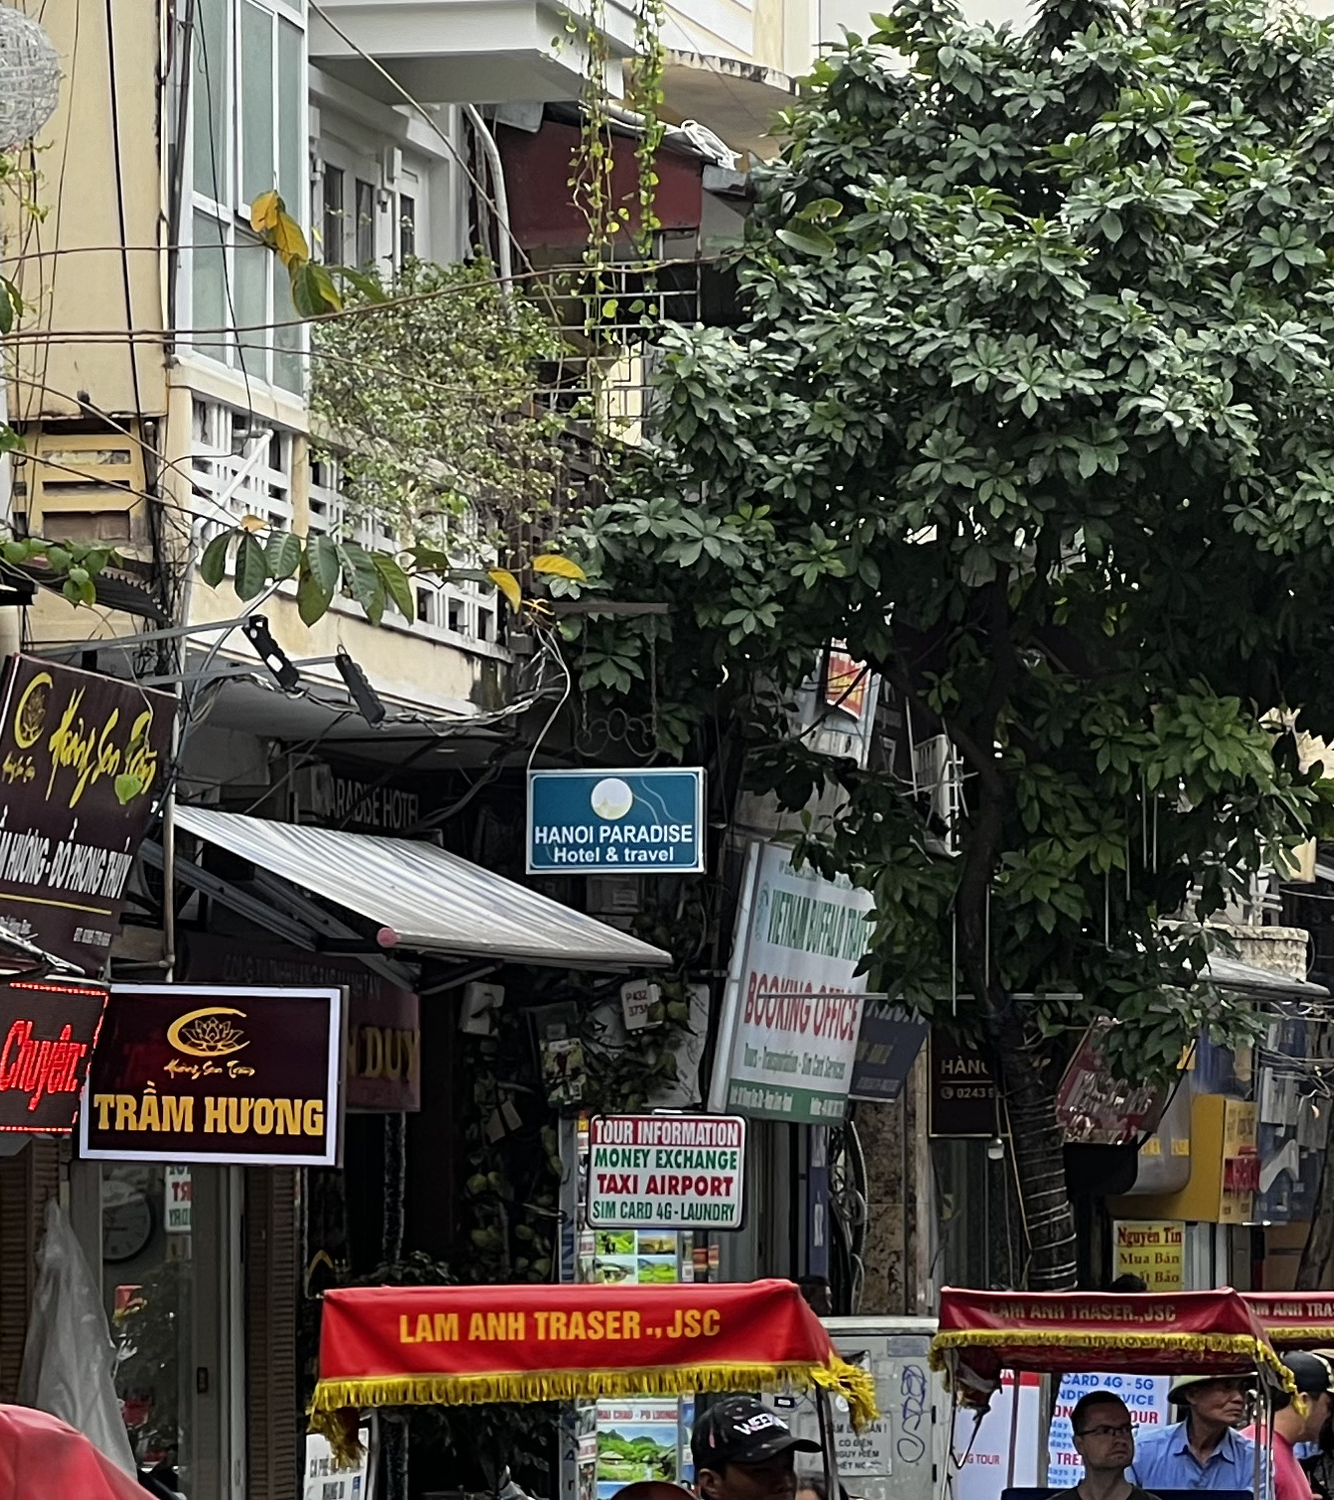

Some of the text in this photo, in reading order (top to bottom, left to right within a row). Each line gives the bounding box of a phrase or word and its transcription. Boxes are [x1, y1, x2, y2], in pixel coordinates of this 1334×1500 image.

[533, 823, 693, 845] HANOI PARADISE
[553, 845, 674, 864] Hotel & travel
[744, 971, 814, 1034] BOOKING
[813, 984, 859, 1042] OFFICE
[366, 1026, 421, 1082] DUY
[93, 1080, 325, 1136] TRẦM HƯƠNG
[595, 1119, 739, 1147] TOUR INFORMATION
[594, 1148, 738, 1171] MONEY EXCHANGE
[597, 1173, 734, 1197] TAXI AIRPORT
[592, 1200, 617, 1219] SIM
[620, 1201, 653, 1220] CARD
[656, 1202, 672, 1220] 4G
[680, 1202, 736, 1222] LAUNDRY
[988, 1301, 1023, 1320] LAM
[1033, 1302, 1066, 1320] ANH
[1250, 1302, 1269, 1316] AM
[1272, 1302, 1304, 1318] ANH
[399, 1313, 459, 1344] LAM
[468, 1311, 524, 1342] ANH
[1061, 1374, 1099, 1387] CARD
[1103, 1376, 1123, 1389] 4G
[1134, 1378, 1155, 1391] 5G
[1119, 1393, 1155, 1406] VICE
[1130, 1410, 1159, 1425] OUR
[976, 1454, 1000, 1465] TOUR
[1056, 1452, 1082, 1466] TRE
